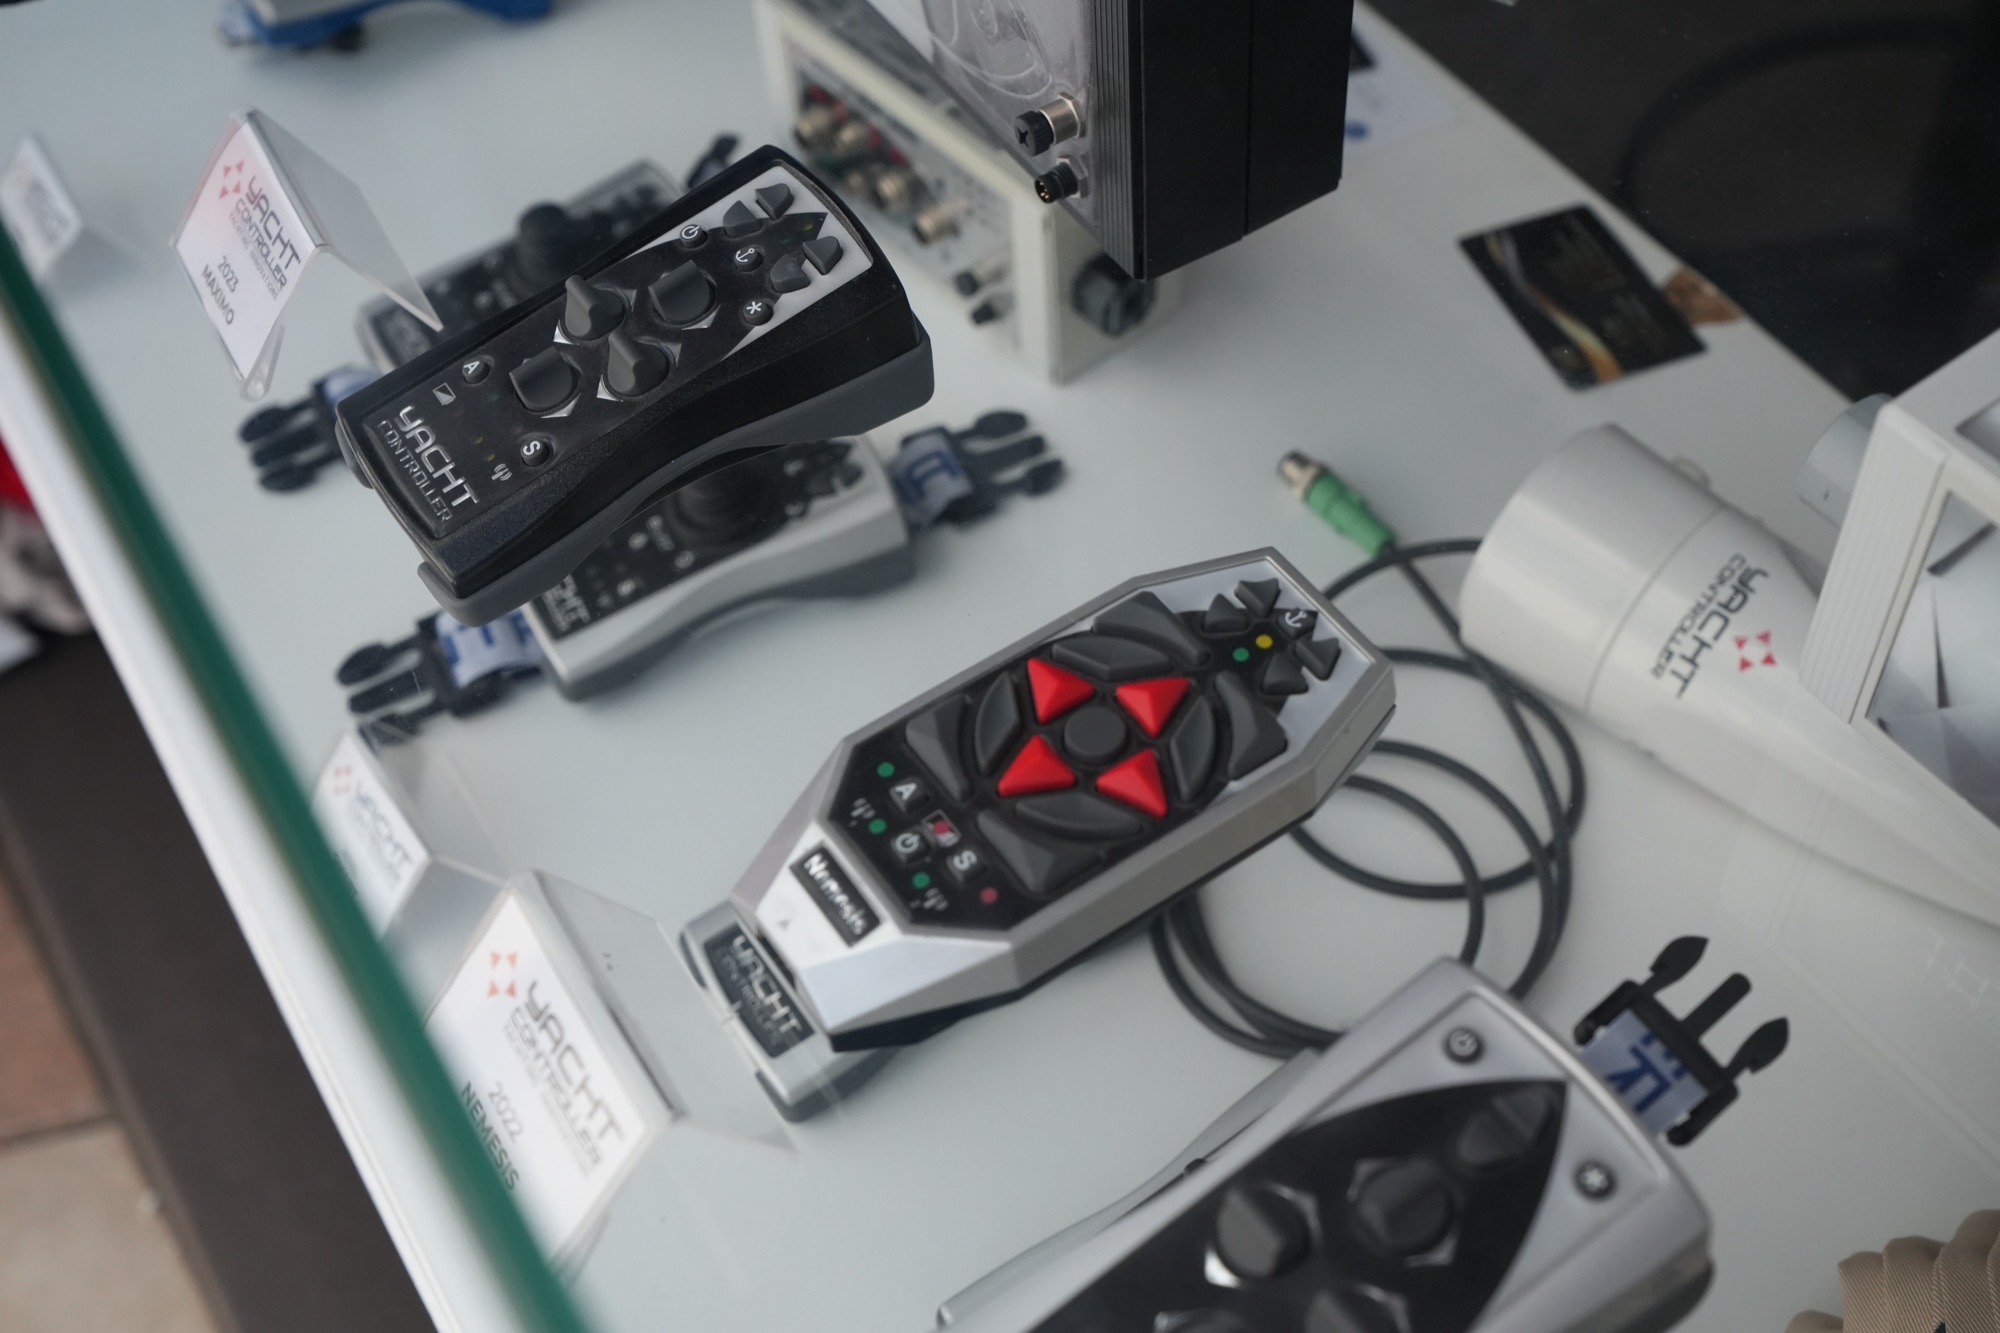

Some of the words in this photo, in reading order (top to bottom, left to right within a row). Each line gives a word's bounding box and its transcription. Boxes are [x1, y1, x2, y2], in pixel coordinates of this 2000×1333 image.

[235, 198, 288, 290] CONTROLLER
[245, 175, 301, 270] YACHT
[201, 263, 235, 325] MAXIMO
[217, 255, 239, 293] 2023
[463, 361, 480, 375] A
[377, 419, 453, 522] CONTROLLER
[394, 404, 480, 507] YACHT
[522, 440, 541, 456] S
[1670, 566, 1769, 700] YACHT
[895, 783, 917, 801] A
[953, 850, 977, 871] S
[524, 979, 627, 1143] YACHT
[461, 1081, 520, 1191] NEMESIS
[487, 1081, 524, 1144] 2022
